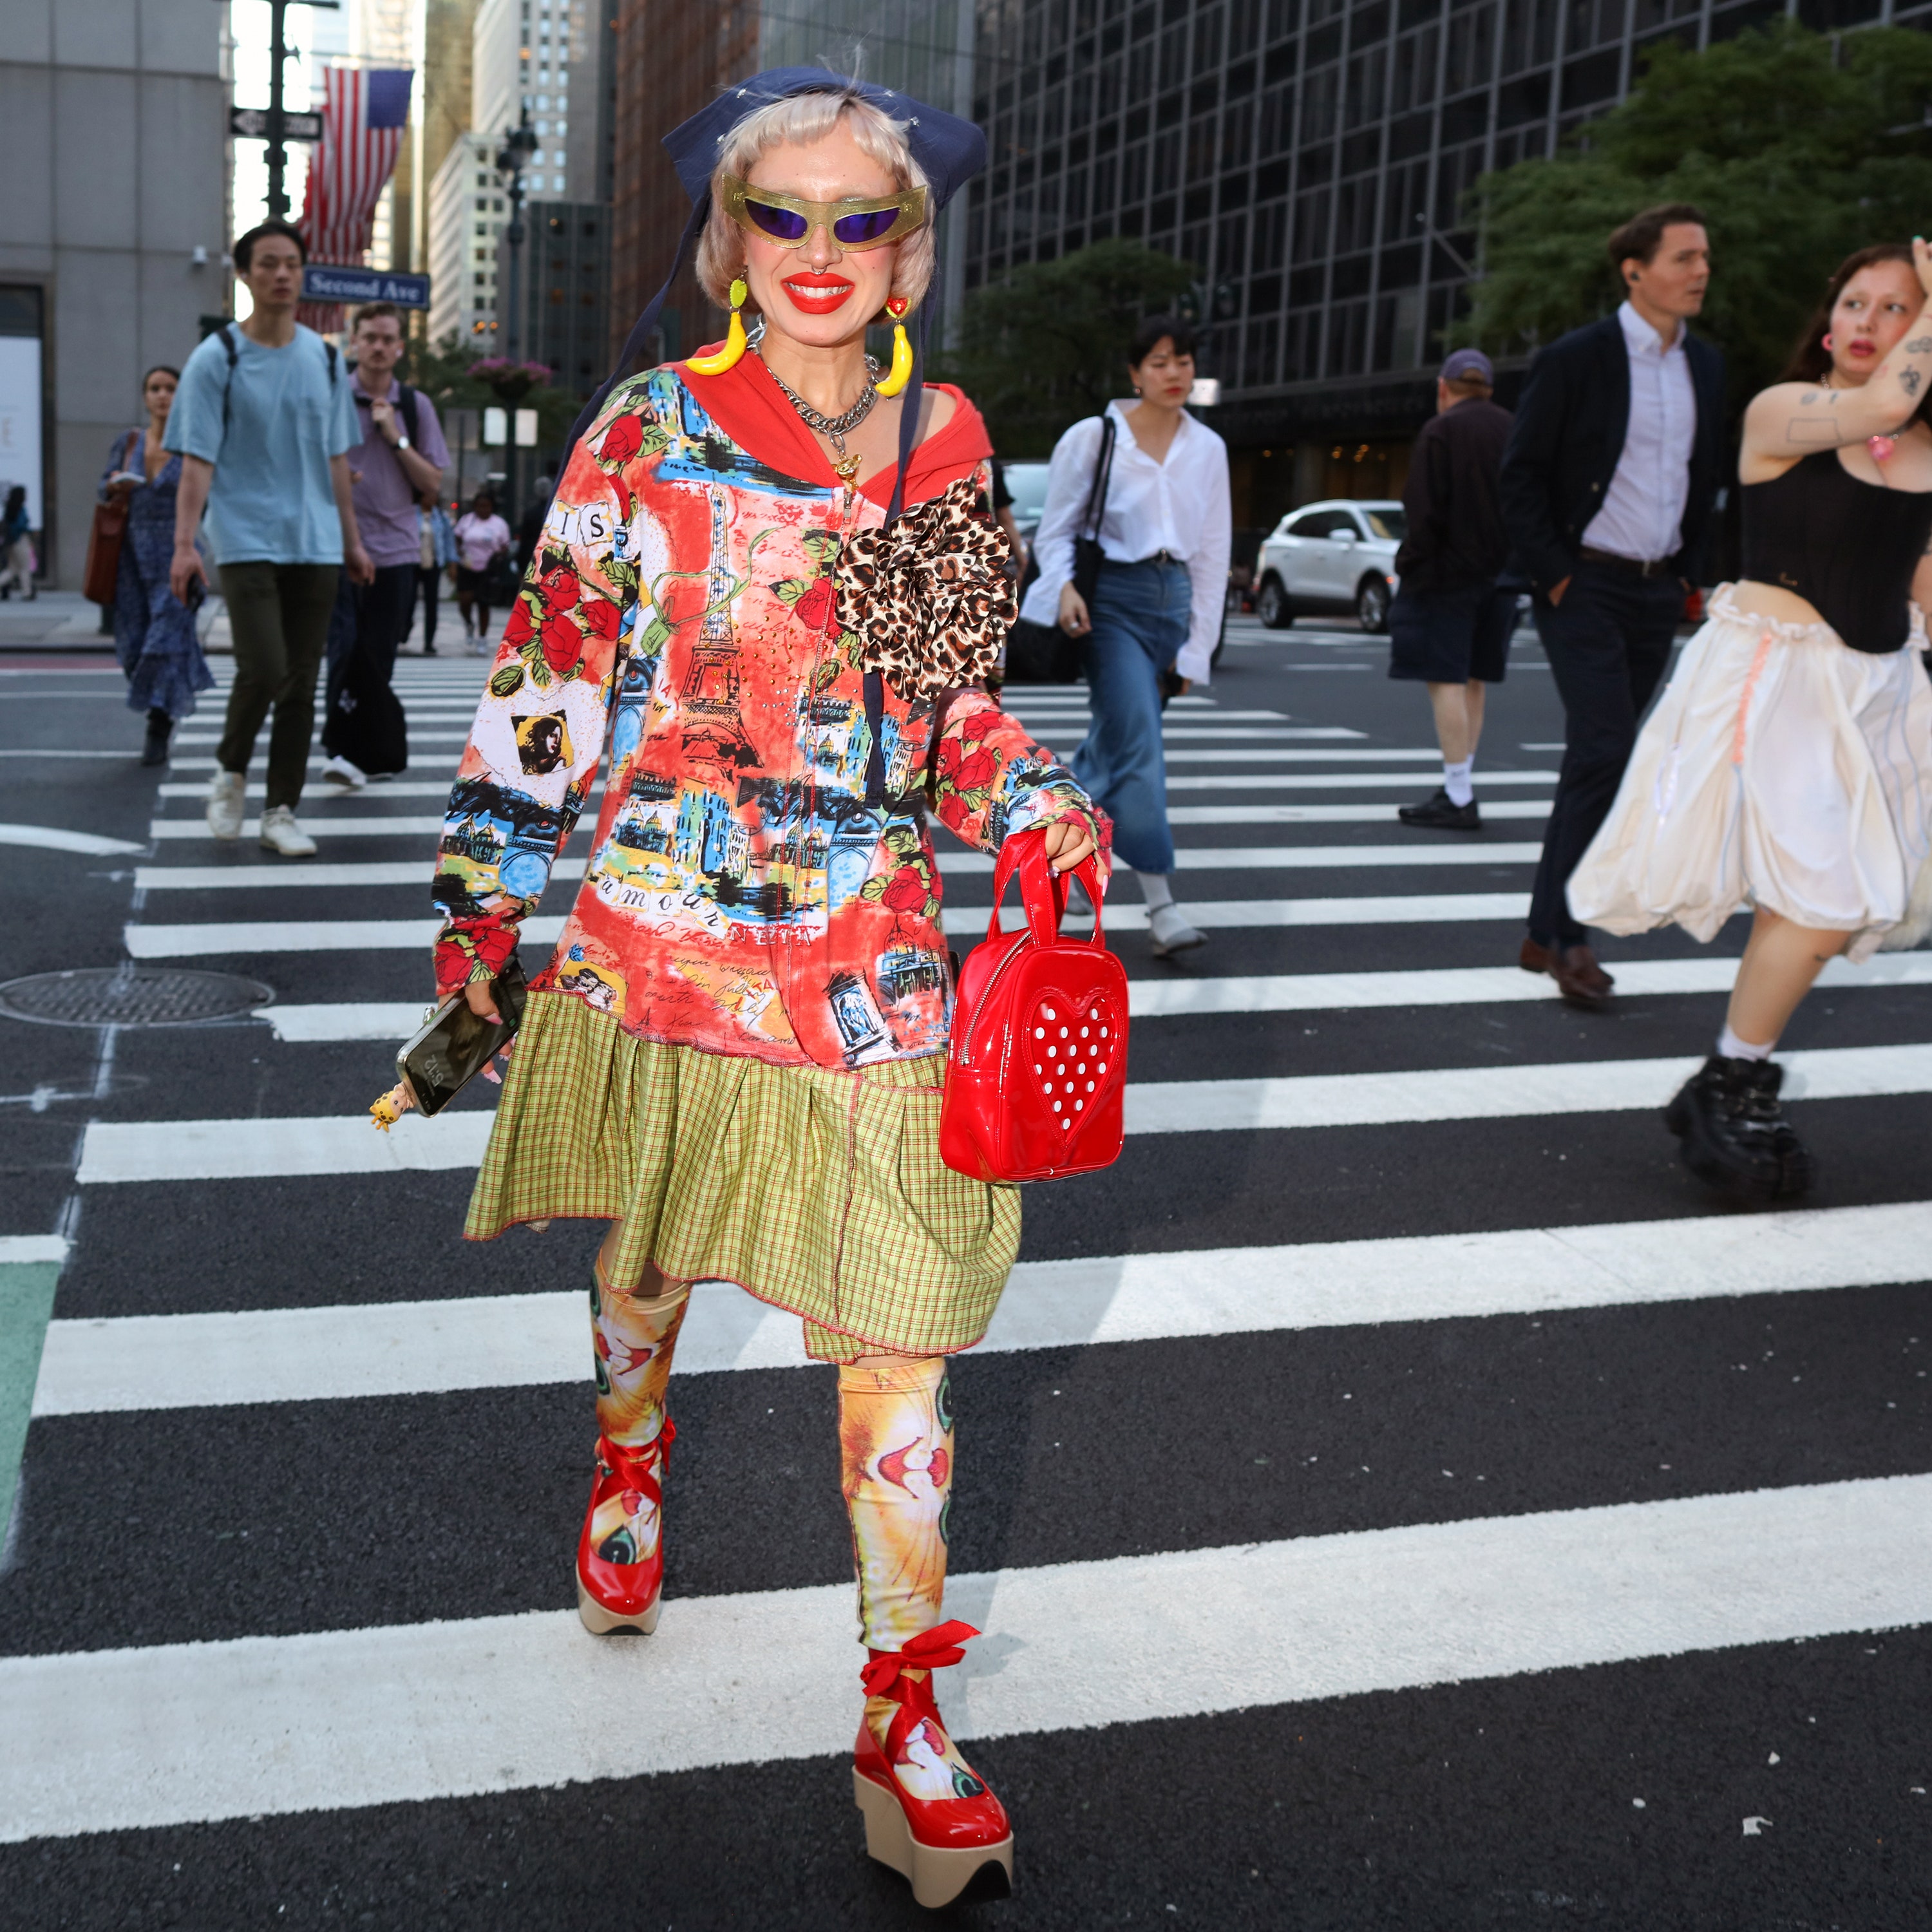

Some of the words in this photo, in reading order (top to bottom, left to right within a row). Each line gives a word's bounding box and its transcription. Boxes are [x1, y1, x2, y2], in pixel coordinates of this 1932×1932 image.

[310, 272, 380, 298] Second
[383, 280, 420, 301] Ave
[601, 880, 719, 927] amour
[424, 1054, 444, 1088] 5:12
